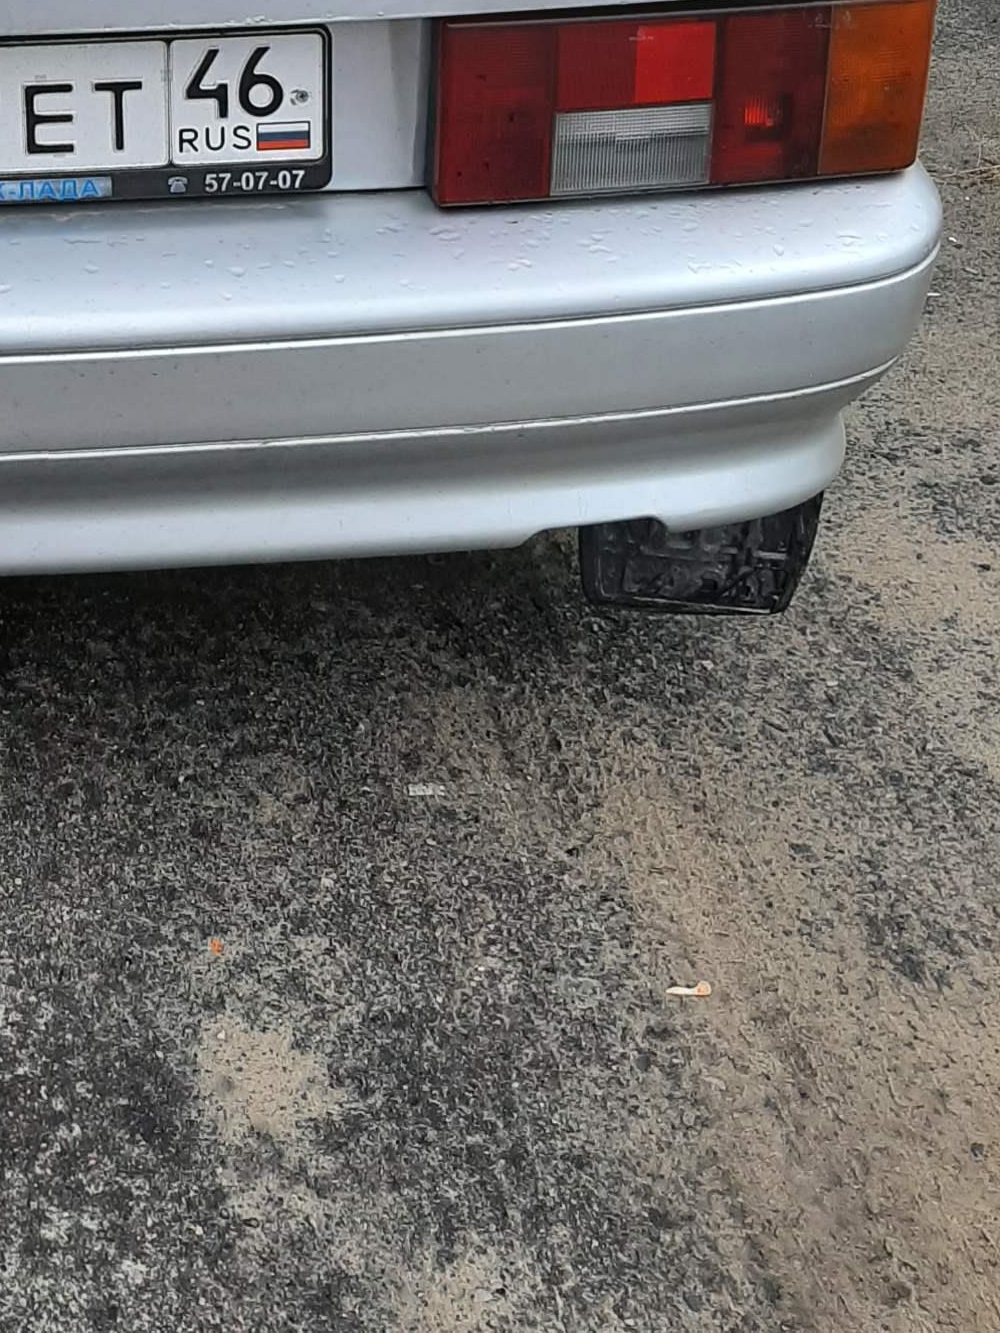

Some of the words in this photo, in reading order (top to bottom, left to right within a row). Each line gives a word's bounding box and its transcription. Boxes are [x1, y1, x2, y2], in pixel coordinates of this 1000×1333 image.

[185, 46, 284, 119] 46
[178, 125, 252, 155] RUS
[204, 169, 305, 194] 57-07-07
